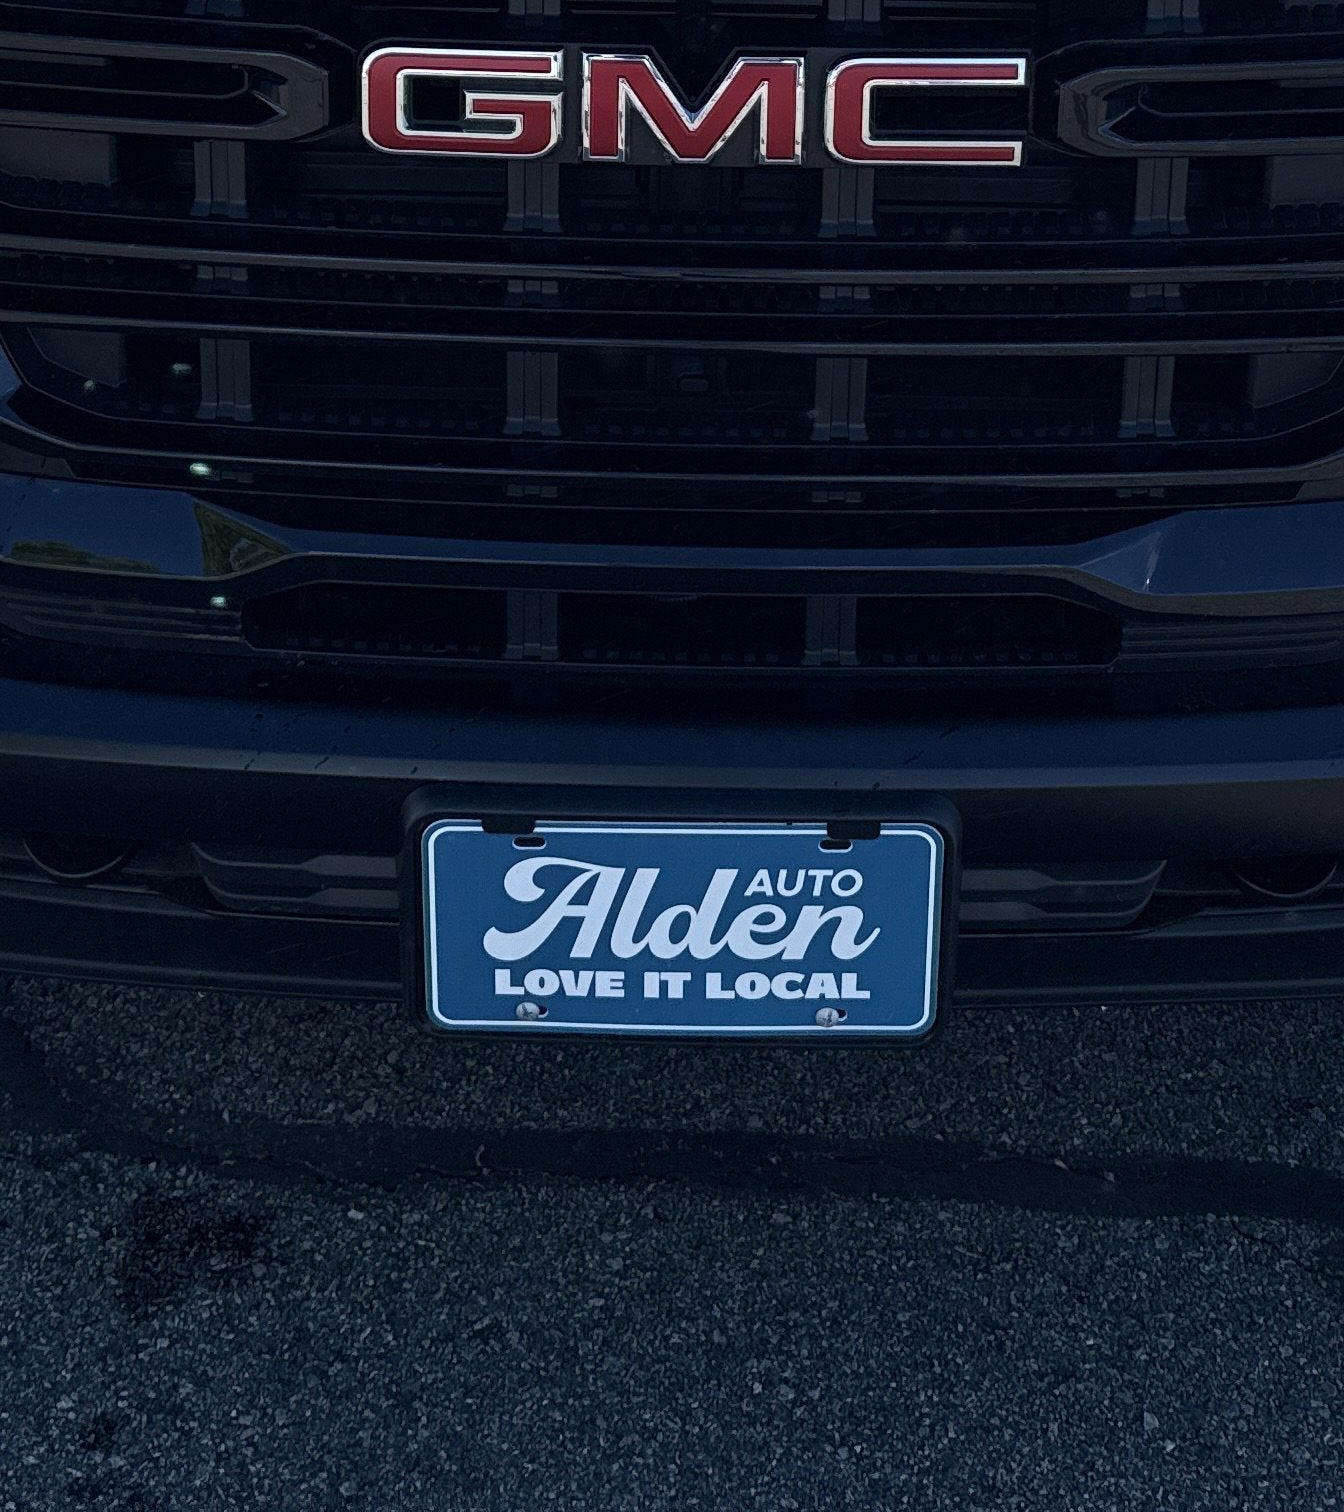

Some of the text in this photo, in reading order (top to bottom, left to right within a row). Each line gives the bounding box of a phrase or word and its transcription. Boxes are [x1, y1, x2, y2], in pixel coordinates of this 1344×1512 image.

[362, 47, 1027, 167] GMC
[483, 856, 881, 961] Alden
[744, 868, 864, 897] AUTO
[494, 968, 871, 999] LOVE IT LOCAL
